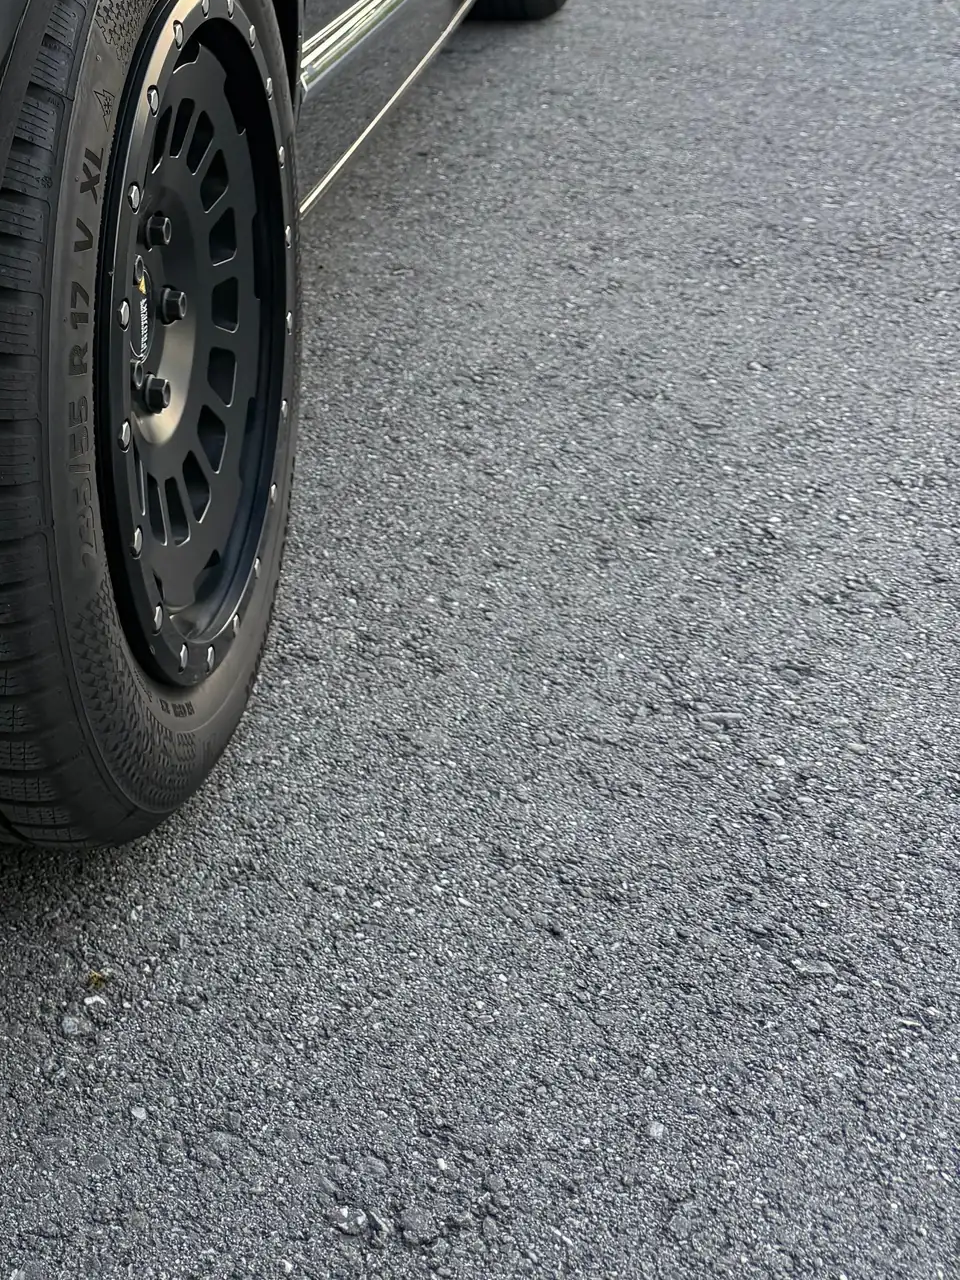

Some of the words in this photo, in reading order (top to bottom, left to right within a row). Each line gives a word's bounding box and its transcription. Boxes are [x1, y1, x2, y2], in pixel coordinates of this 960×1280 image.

[80, 147, 105, 205] XL
[74, 217, 94, 253] V
[70, 281, 91, 331] 17
[68, 341, 89, 376] R
